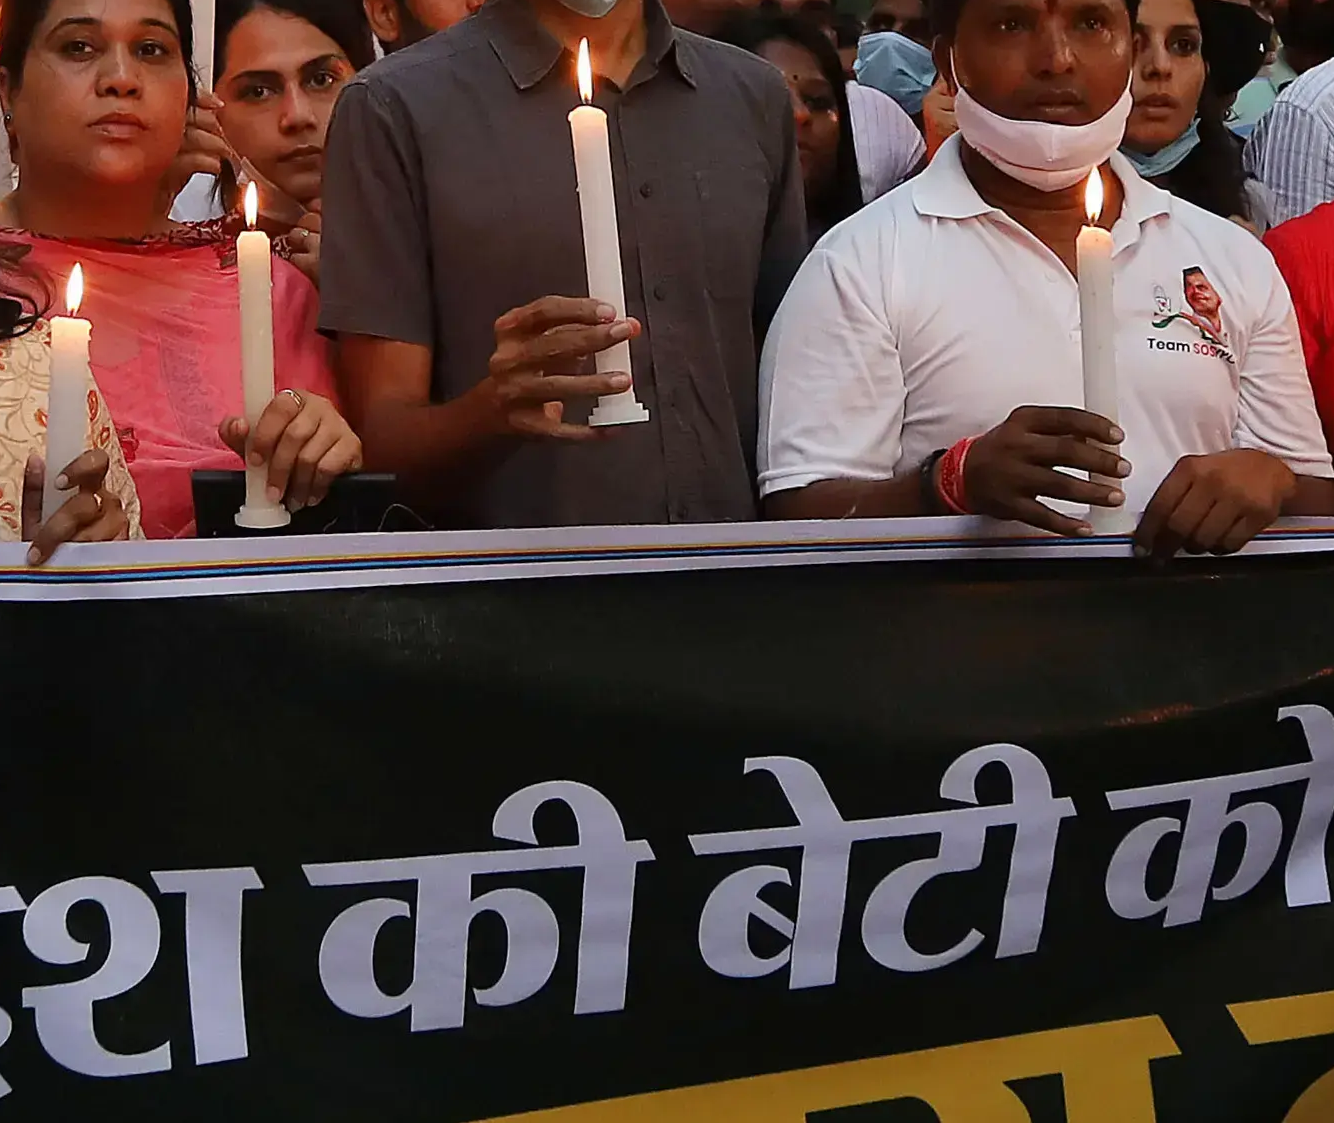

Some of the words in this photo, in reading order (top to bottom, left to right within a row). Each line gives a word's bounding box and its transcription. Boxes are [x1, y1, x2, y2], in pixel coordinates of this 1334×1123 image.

[1147, 338, 1190, 353] Team
[301, 780, 655, 1032] की
[688, 743, 1077, 989] बेटी
